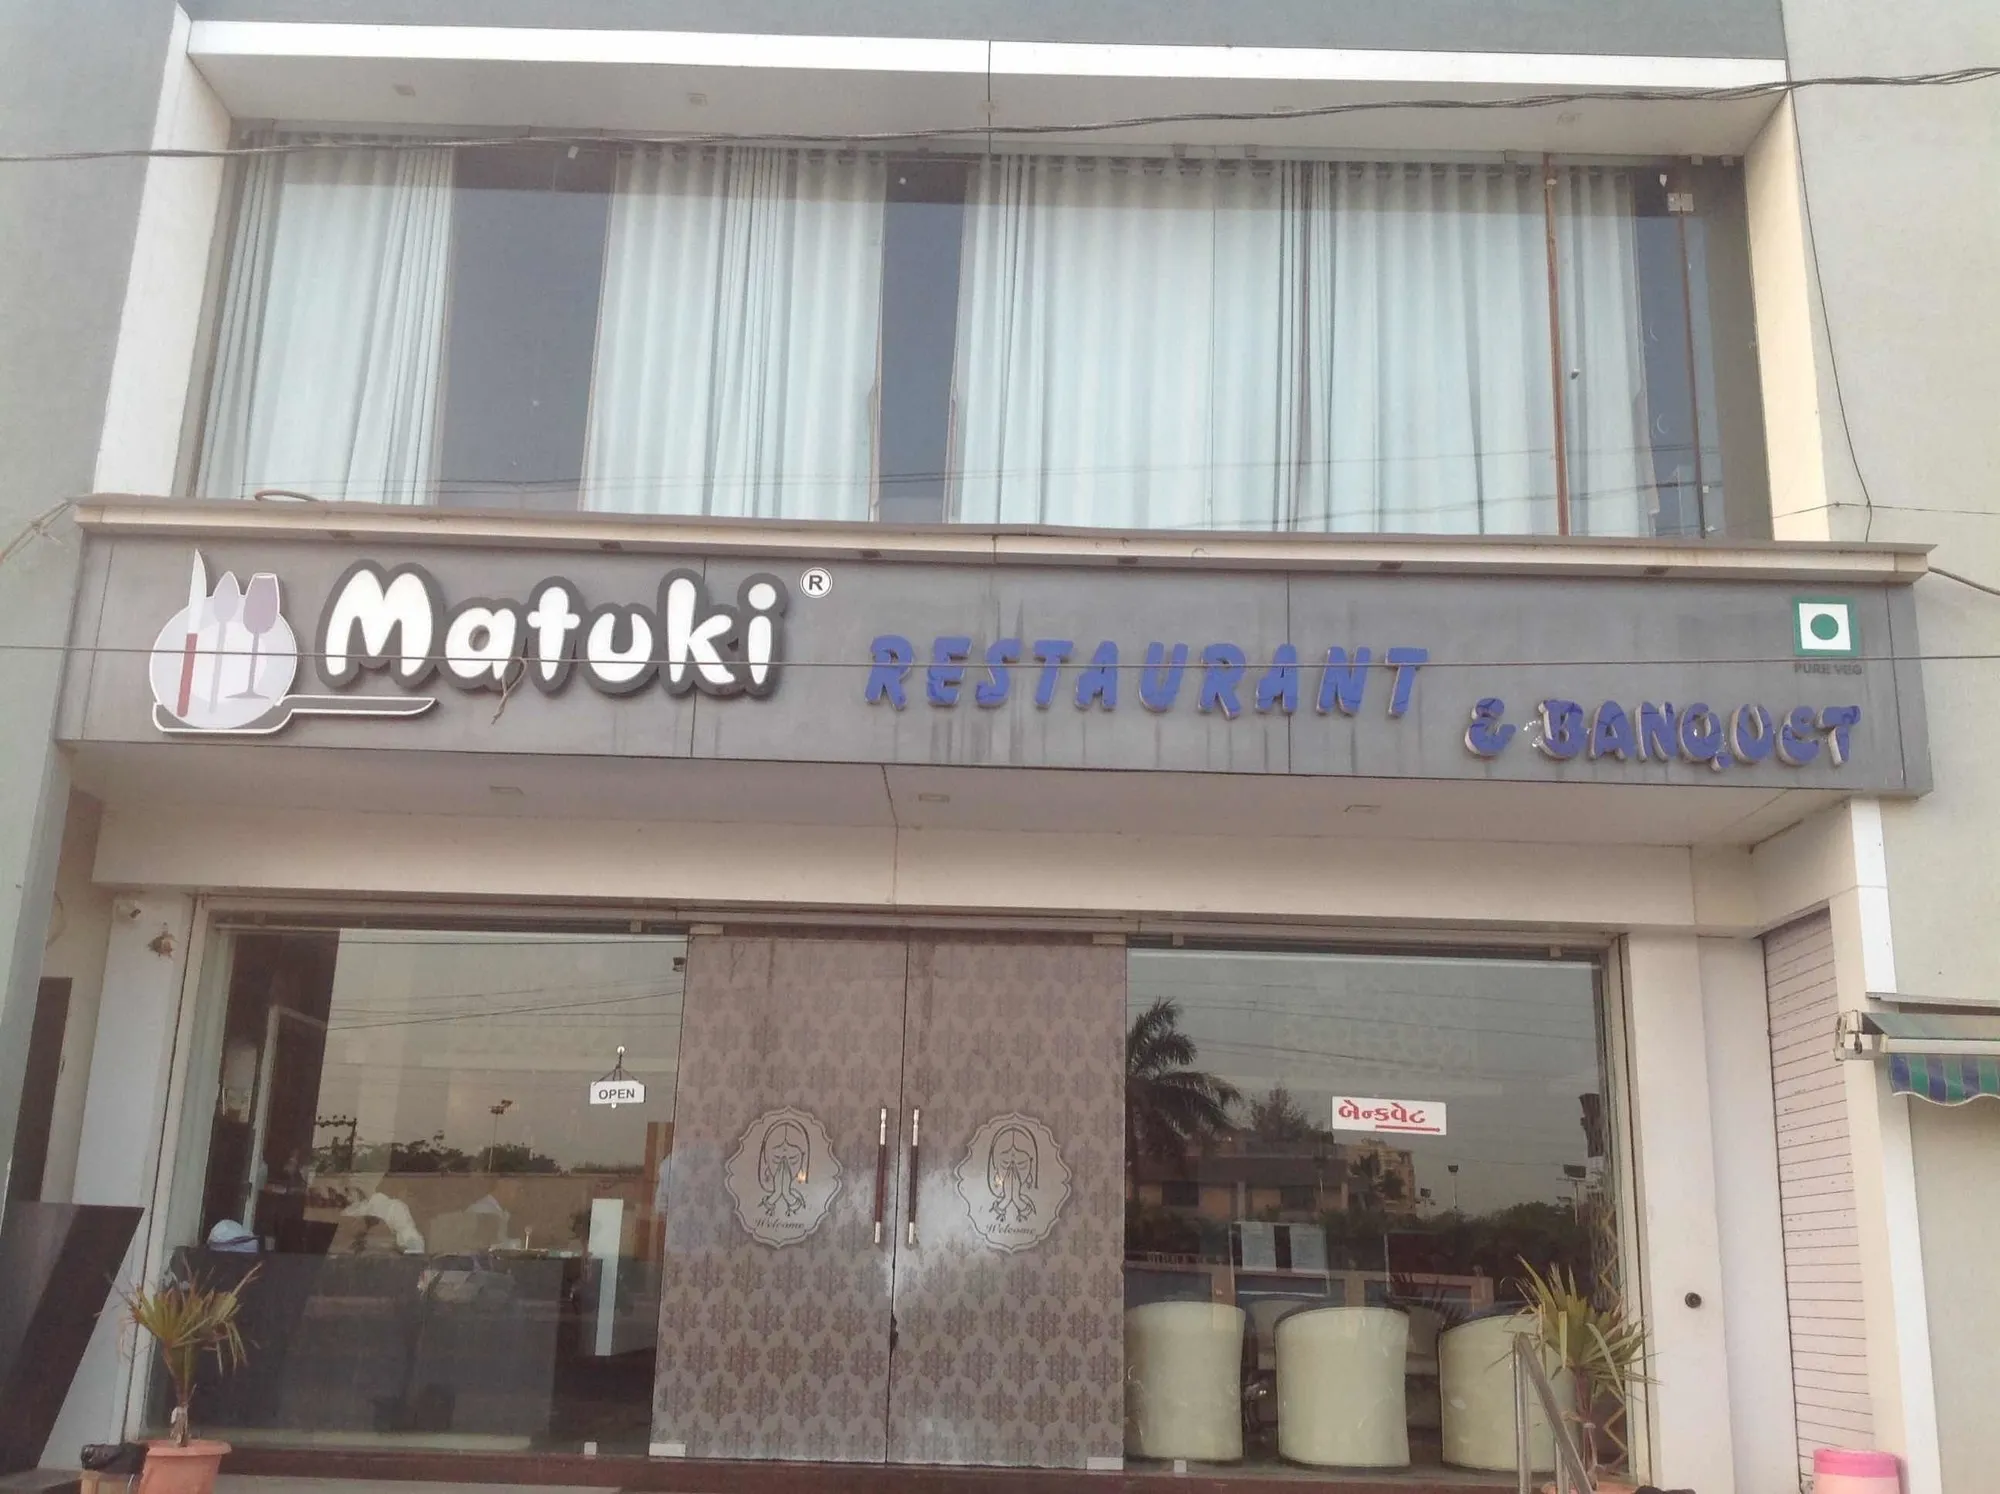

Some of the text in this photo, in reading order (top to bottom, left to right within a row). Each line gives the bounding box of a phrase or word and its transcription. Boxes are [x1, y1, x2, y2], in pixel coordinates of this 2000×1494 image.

[322, 567, 779, 686] Matuki
[865, 634, 1428, 720] RESTAURANT
[1794, 662, 1830, 675] PURE
[1465, 697, 1861, 771] & BANQUET
[598, 1088, 635, 1100] OPEN
[985, 1223, 1036, 1235] Welcome
